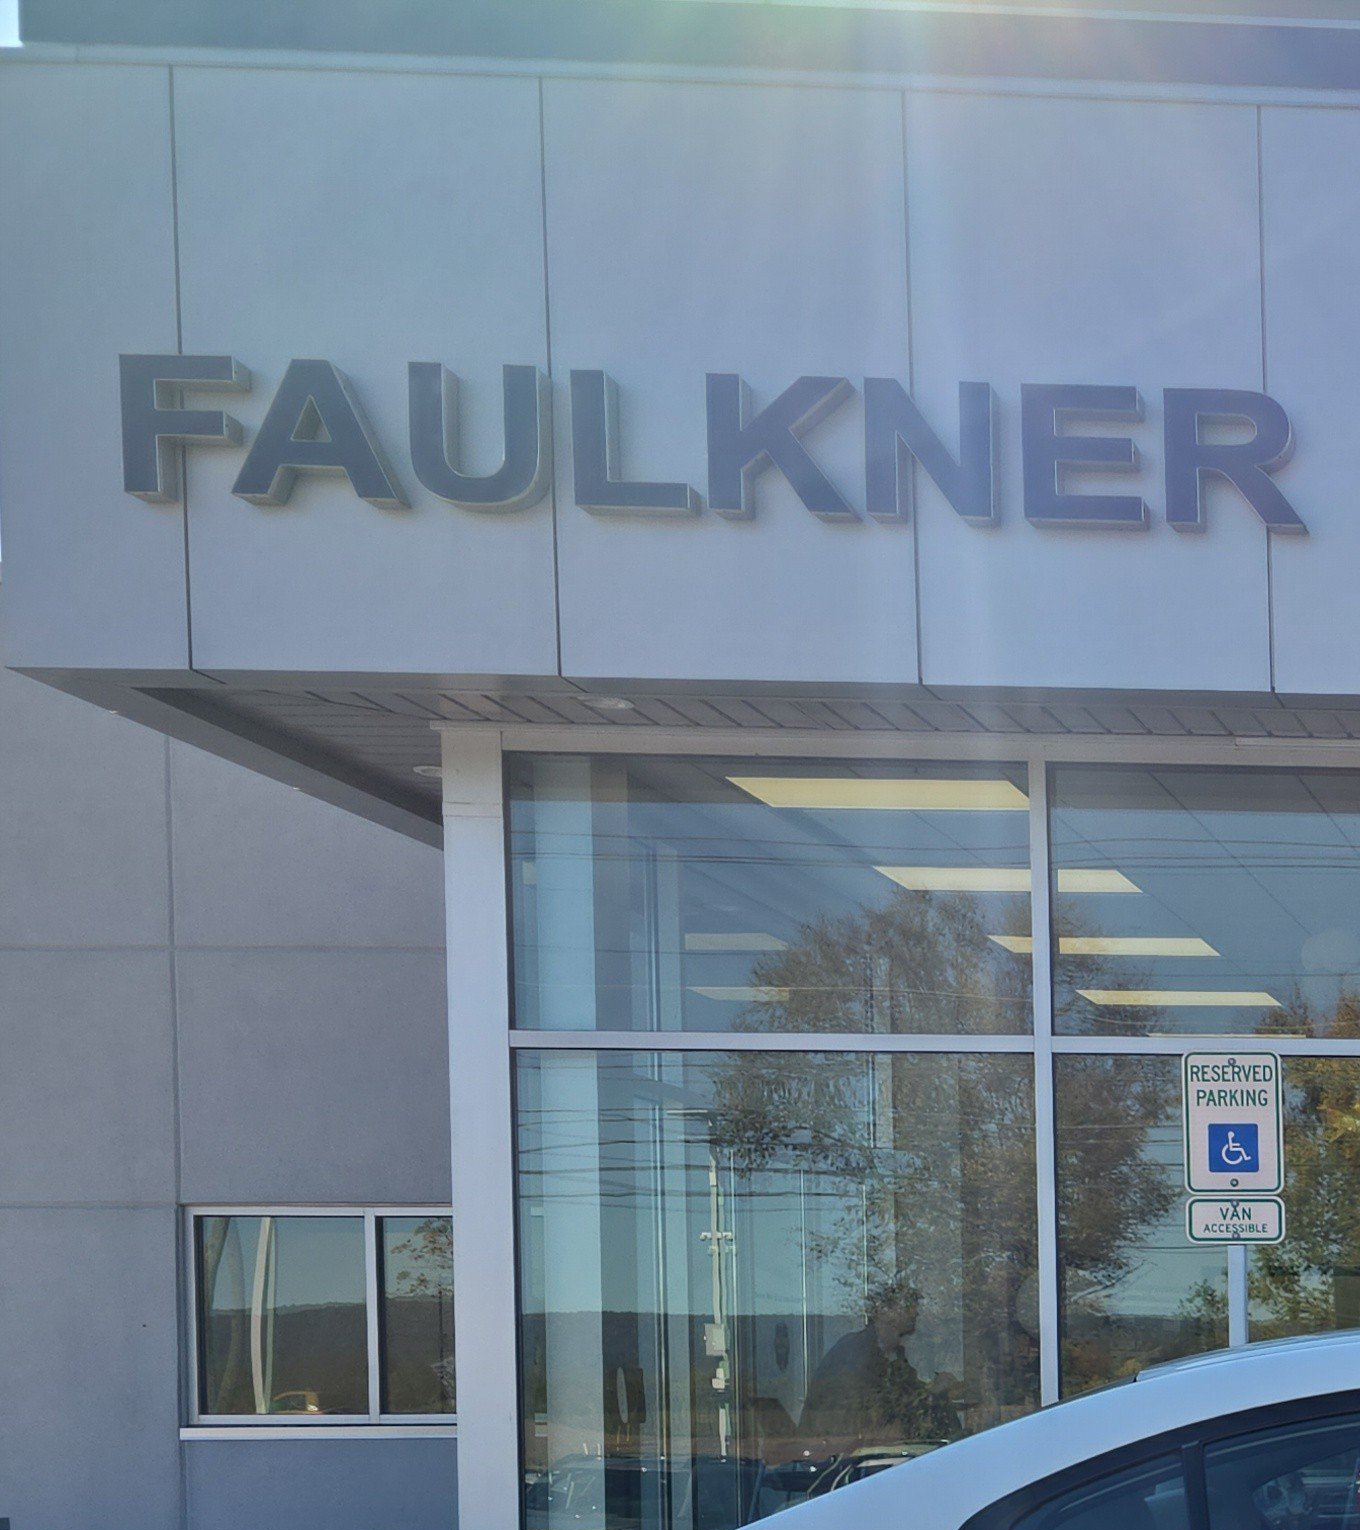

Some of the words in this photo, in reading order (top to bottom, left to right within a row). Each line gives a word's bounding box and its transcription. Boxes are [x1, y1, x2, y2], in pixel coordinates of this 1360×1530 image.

[118, 352, 1308, 535] FAULKNER
[1190, 1065, 1273, 1082] RESERVED
[1196, 1089, 1268, 1106] PARKING
[1219, 1207, 1252, 1221] VAN
[1203, 1223, 1268, 1234] ACCESSIBLE
